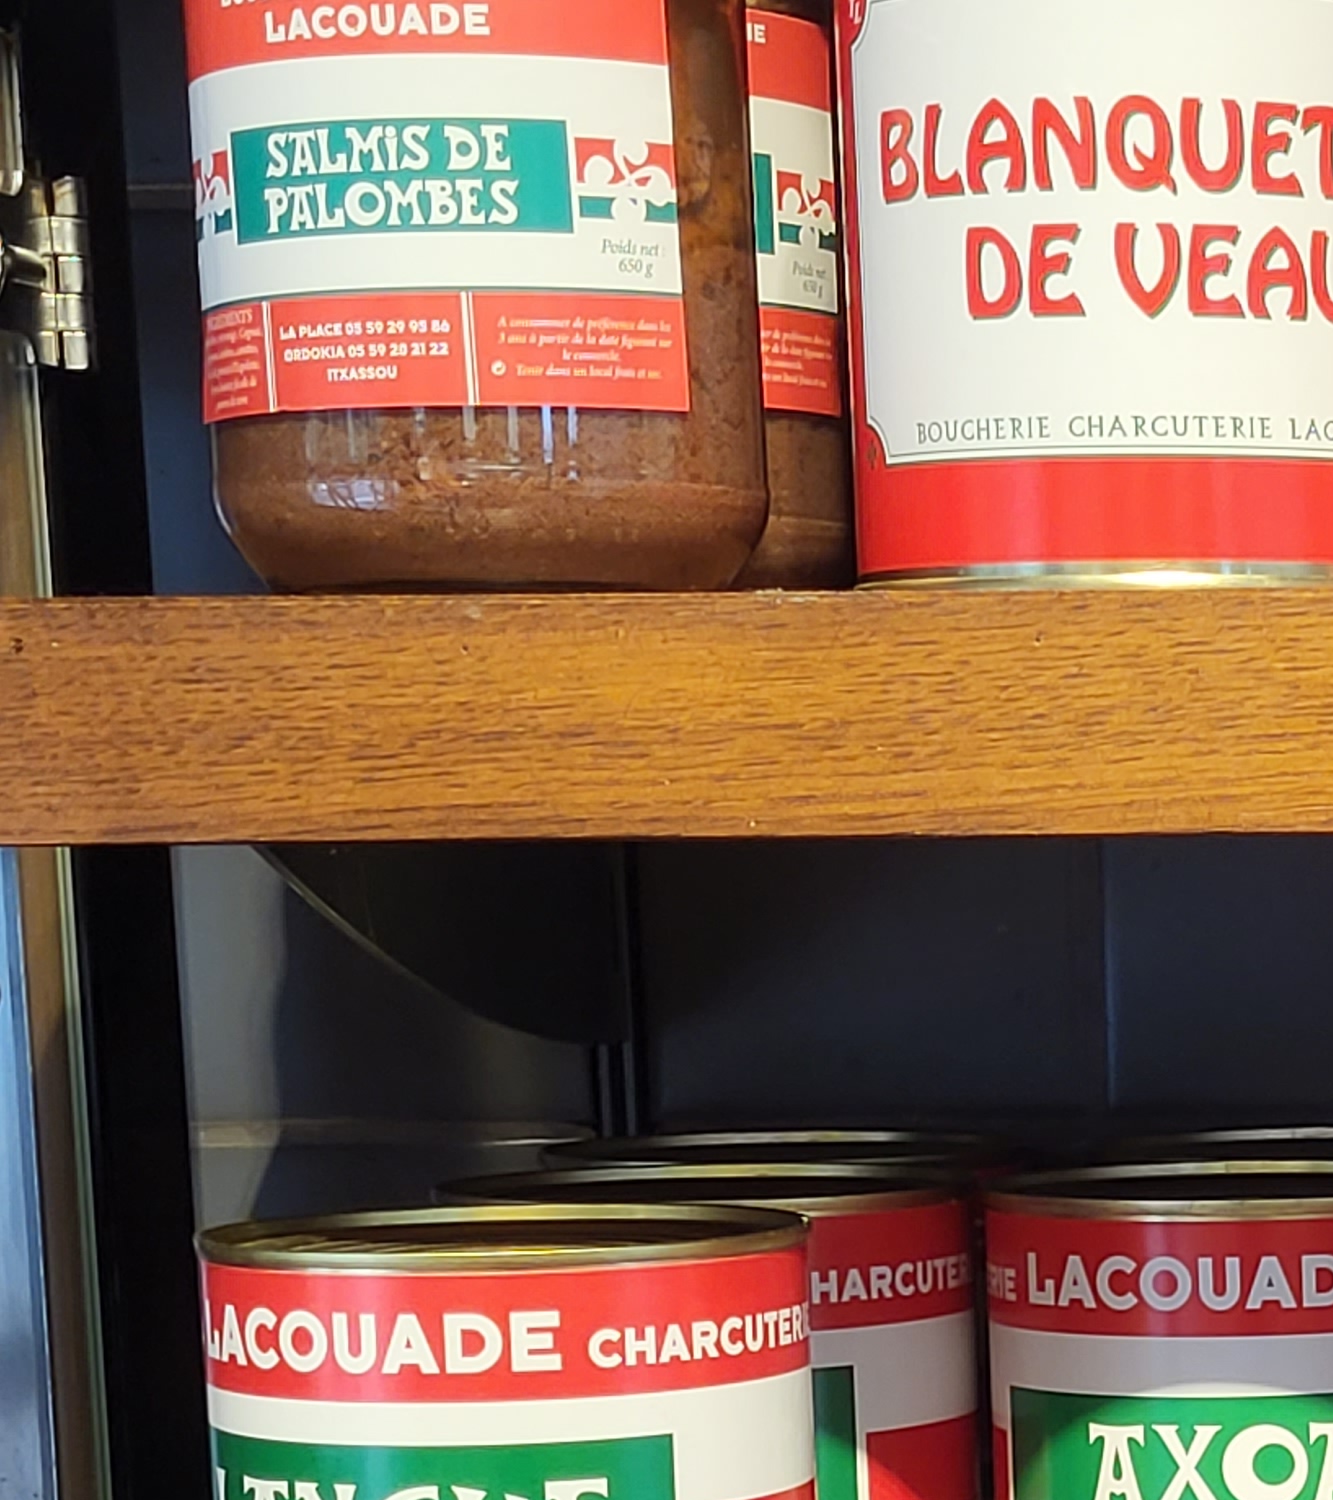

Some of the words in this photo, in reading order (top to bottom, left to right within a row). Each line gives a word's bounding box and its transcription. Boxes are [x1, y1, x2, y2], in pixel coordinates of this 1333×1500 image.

[264, 3, 490, 43] LACOUADE
[444, 125, 510, 172] DE
[264, 179, 518, 233] PALOMBES
[602, 238, 638, 255] Poids
[618, 257, 643, 273] 650
[644, 262, 653, 279] g
[964, 222, 1086, 320] DE
[279, 324, 296, 340] LA
[298, 320, 342, 338] PLACE
[345, 320, 362, 336] 05
[365, 320, 384, 335] 59
[387, 319, 405, 335] 29
[283, 343, 345, 362] ORDOKIA
[326, 364, 398, 382] ITXASSOU
[916, 415, 1050, 445] BOUCHERIE
[1068, 414, 1273, 440] CHARCUTERIE
[204, 1298, 563, 1376] LACOUADE
